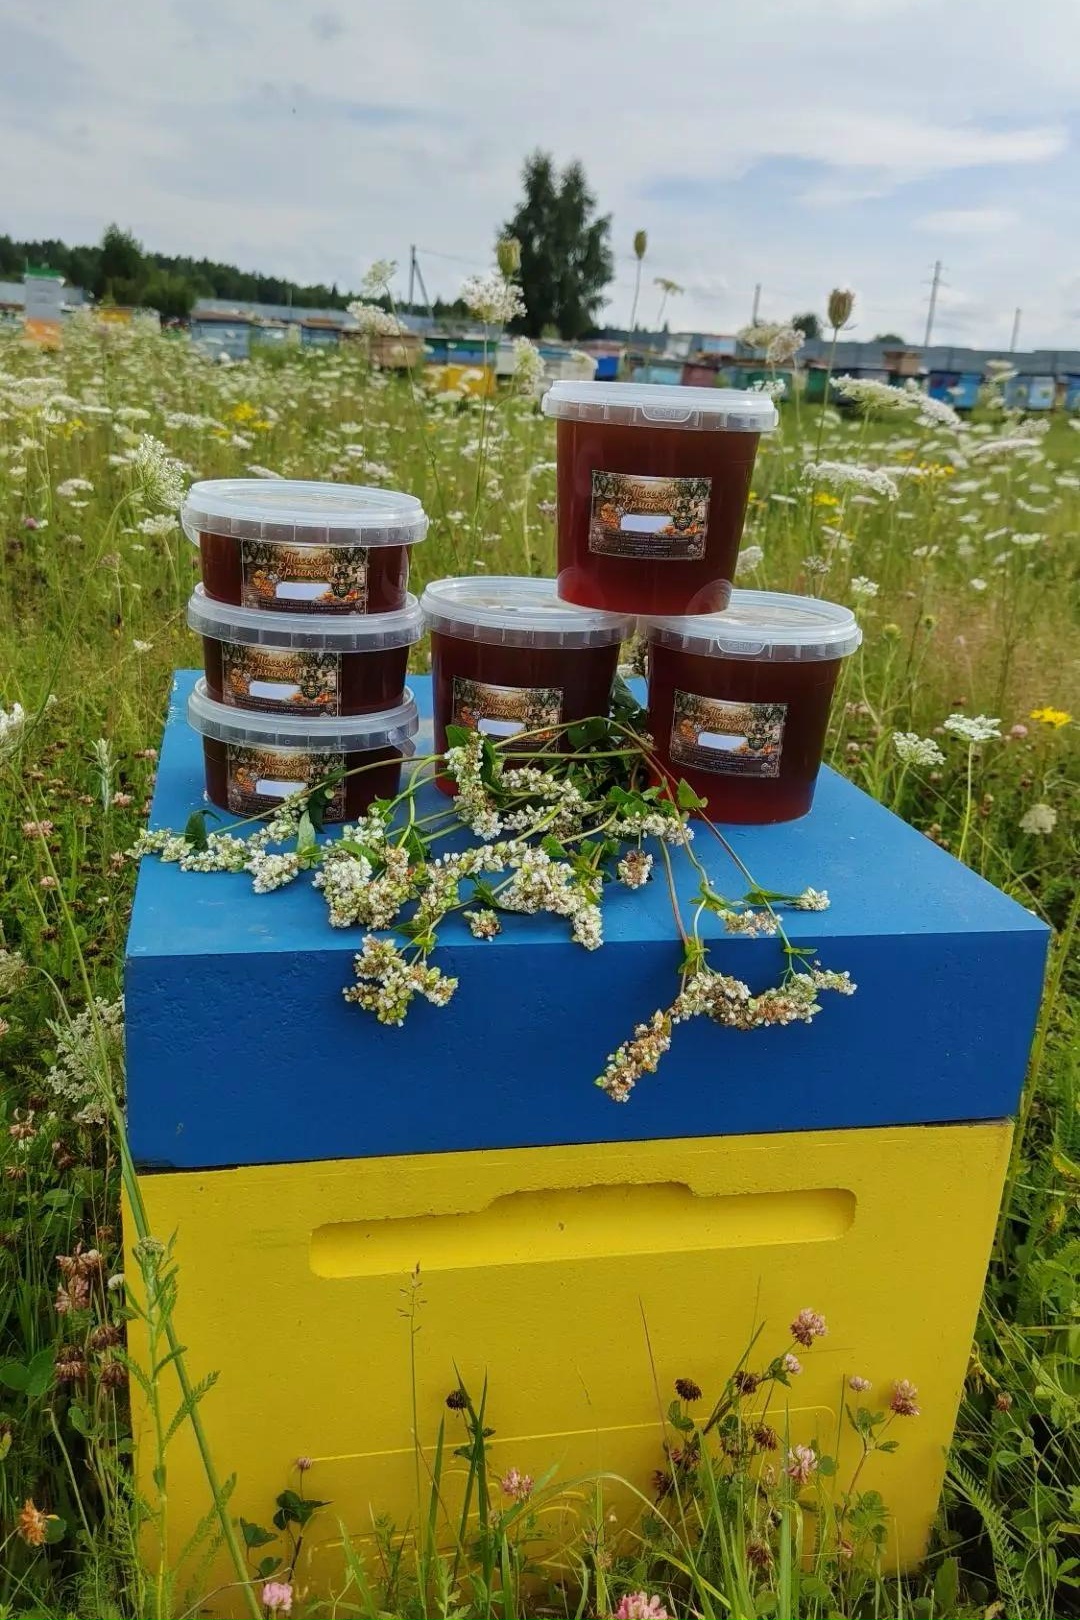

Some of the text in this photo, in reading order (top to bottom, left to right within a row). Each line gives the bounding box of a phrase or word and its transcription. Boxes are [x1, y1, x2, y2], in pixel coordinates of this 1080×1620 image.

[630, 484, 669, 499] Пасека
[283, 551, 324, 566] Пасека
[276, 562, 333, 579] Ермакова
[256, 653, 294, 669] Пасека
[262, 753, 300, 767] Пасека
